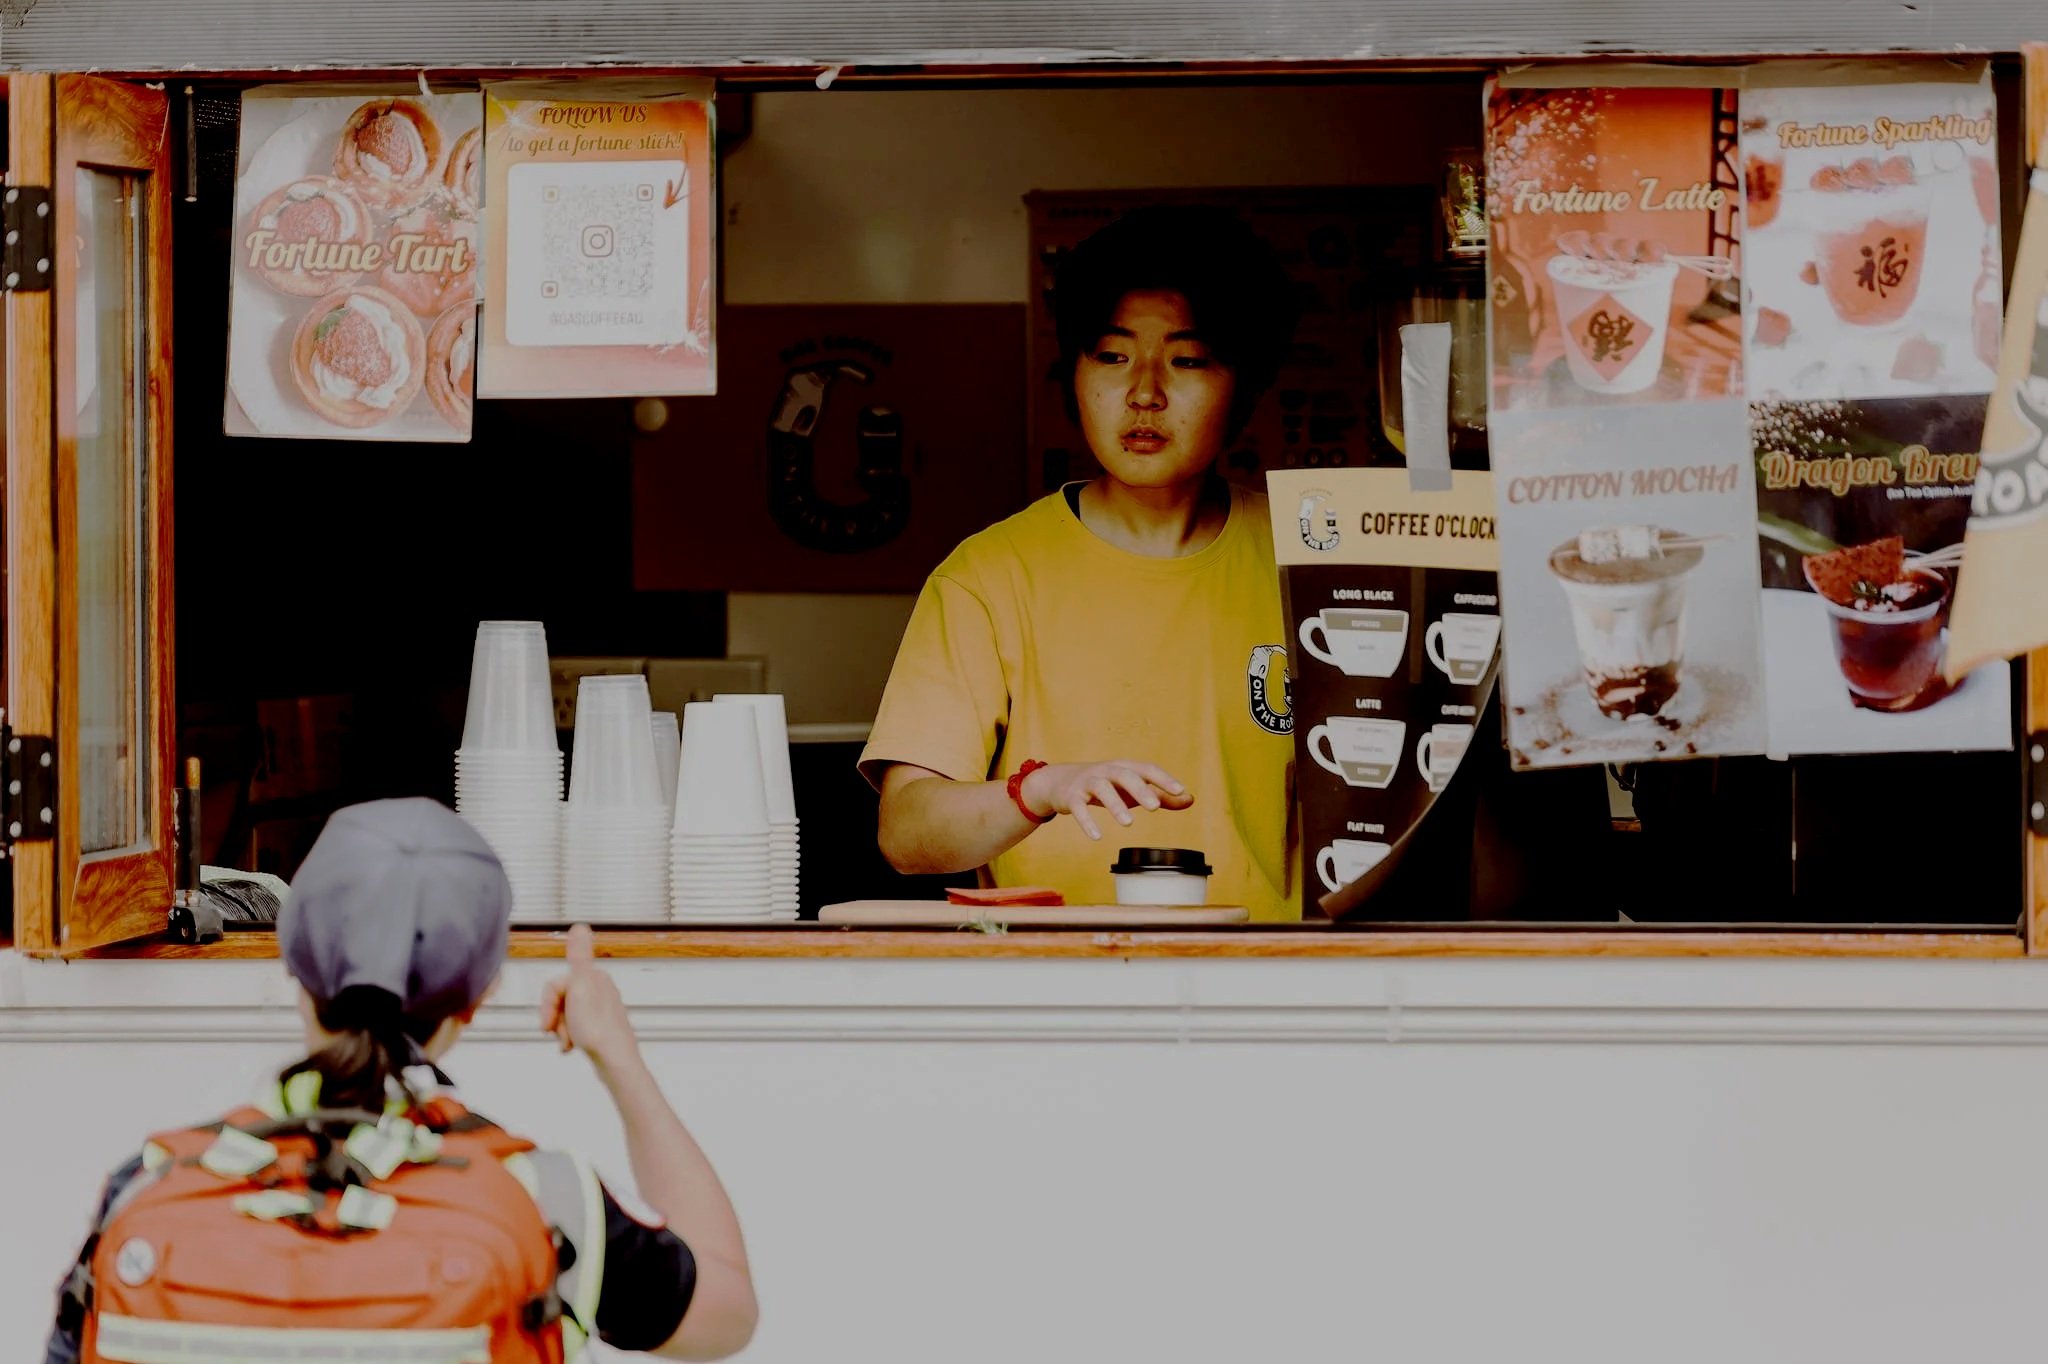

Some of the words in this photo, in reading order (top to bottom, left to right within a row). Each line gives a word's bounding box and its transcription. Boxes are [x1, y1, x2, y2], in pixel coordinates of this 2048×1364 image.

[539, 105, 618, 129] FOLLOW
[619, 105, 648, 124] US
[1776, 121, 1868, 149] Fortune
[1872, 115, 1992, 150] Sparkling
[508, 136, 523, 152] to
[528, 138, 554, 157] get
[558, 141, 569, 152] a
[572, 134, 633, 156] fortune
[639, 133, 682, 150] stick!
[1512, 178, 1632, 214] Fortune
[1638, 178, 1726, 212] Latte
[244, 229, 384, 273] Fortune
[388, 232, 470, 275] Tart
[1507, 471, 1623, 505] COTTON
[1631, 463, 1739, 496] MOCHA
[1759, 450, 1898, 496] Dragon
[1361, 512, 1430, 536] COFFEE
[1333, 589, 1362, 600] LONG
[1363, 590, 1394, 601] BLACK
[1252, 679, 1263, 700] ON
[1255, 702, 1277, 728] THE
[1355, 698, 1382, 710] LATTE
[1347, 821, 1364, 832] FLAT
